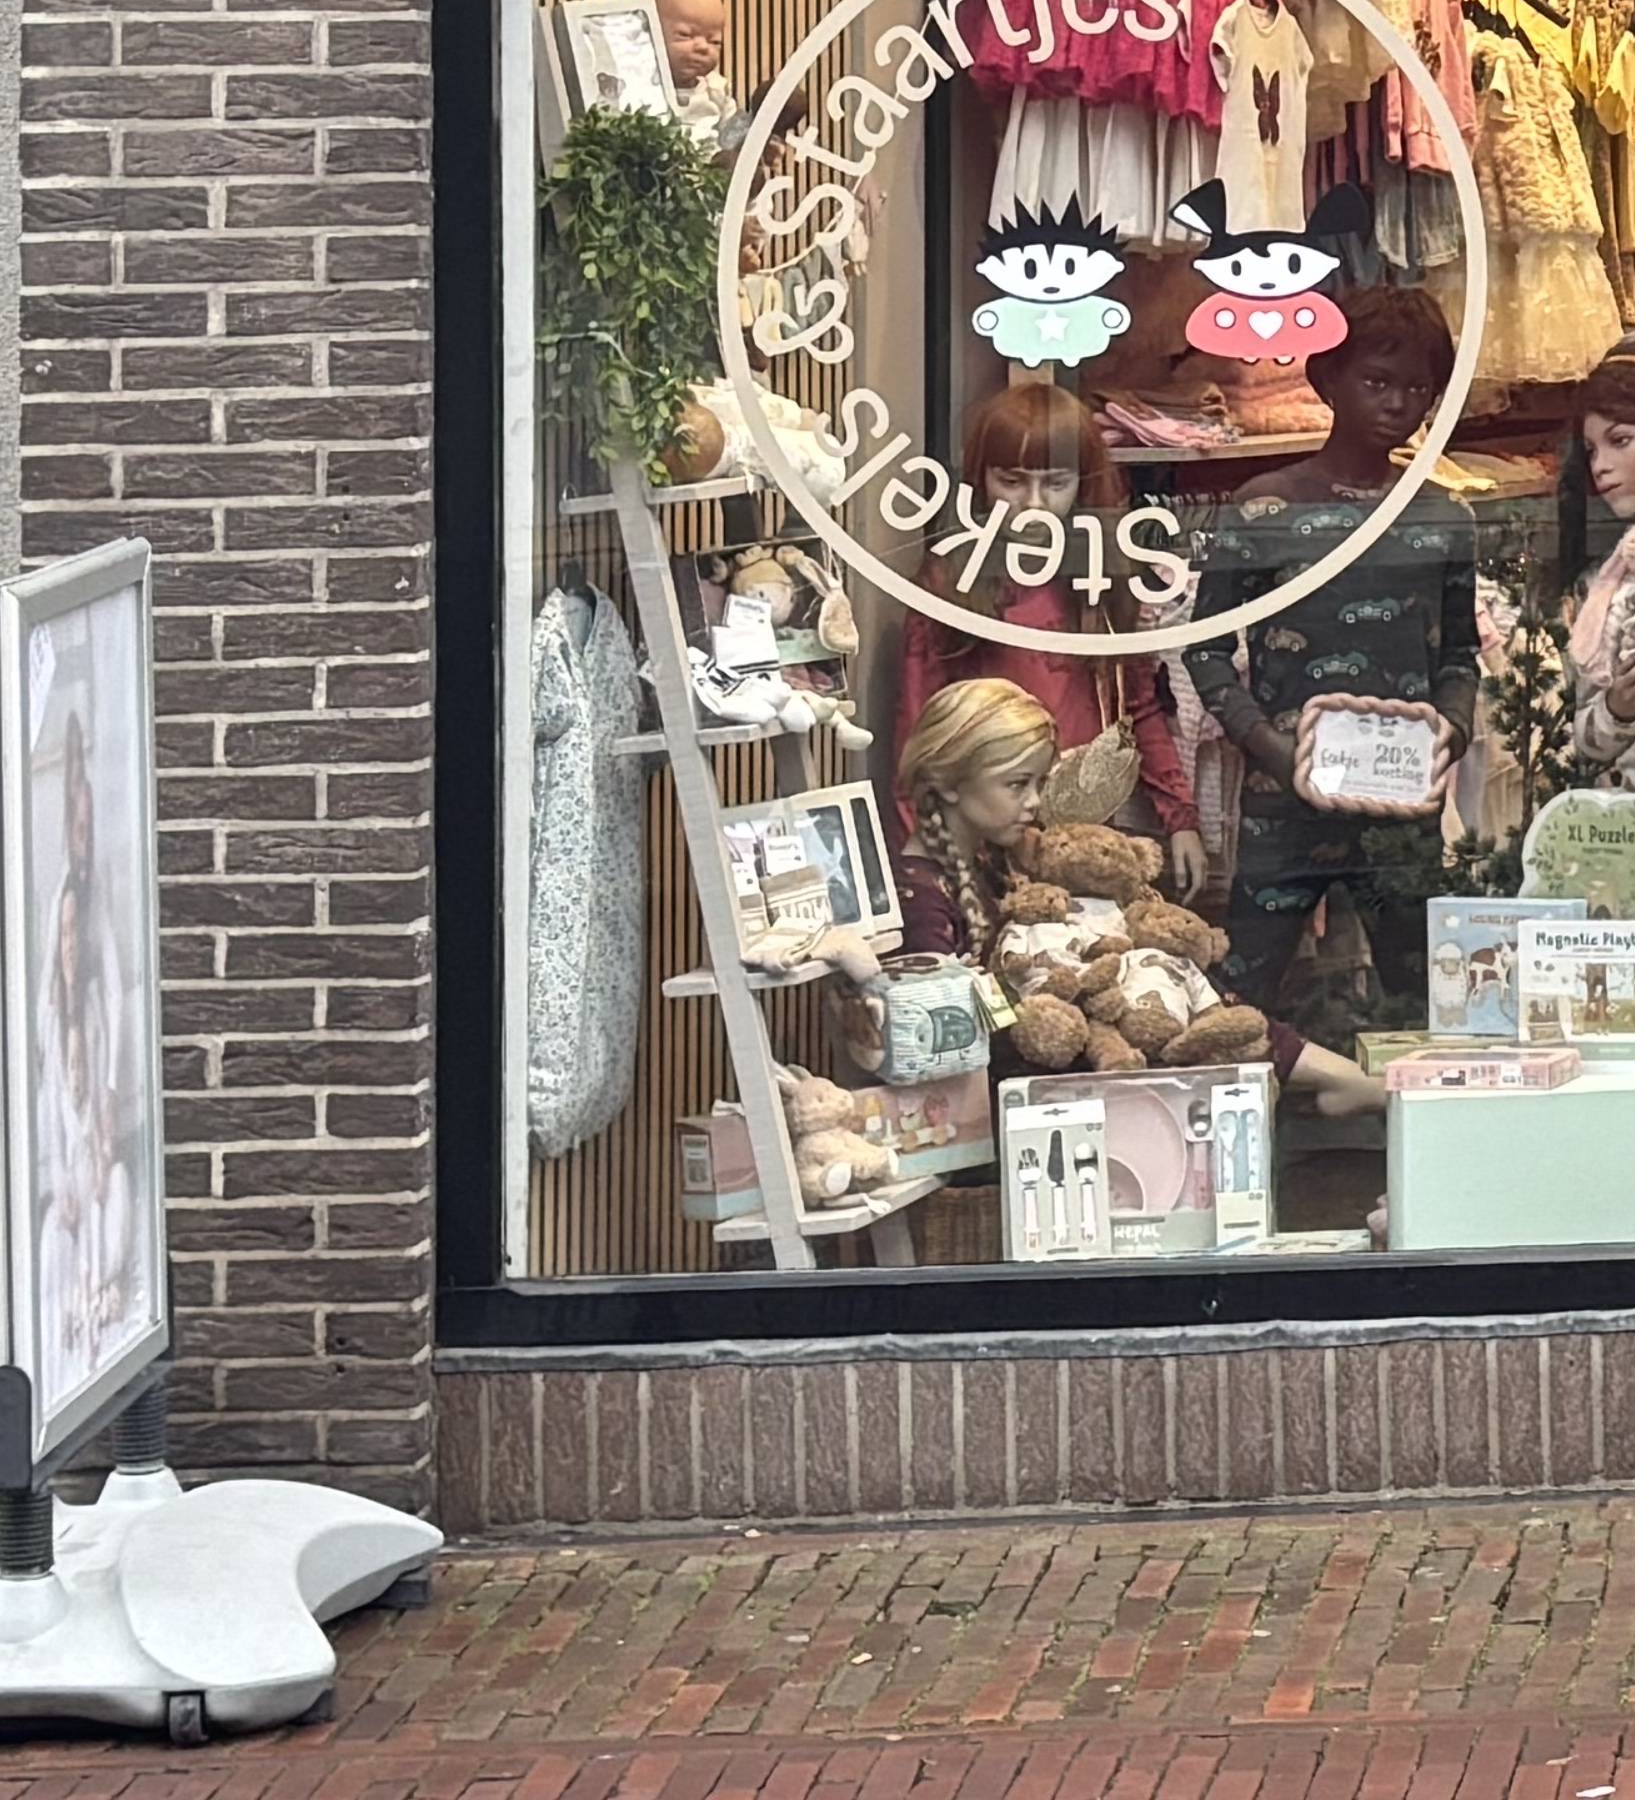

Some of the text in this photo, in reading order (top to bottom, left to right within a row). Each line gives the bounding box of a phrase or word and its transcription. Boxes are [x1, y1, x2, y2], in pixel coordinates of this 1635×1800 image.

[752, 276, 856, 365] &
[814, 388, 1199, 606] Stekels
[1374, 743, 1422, 767] 20%
[1373, 764, 1425, 785] korting
[1567, 824, 1583, 843] XL
[1536, 931, 1598, 950] Magnetic
